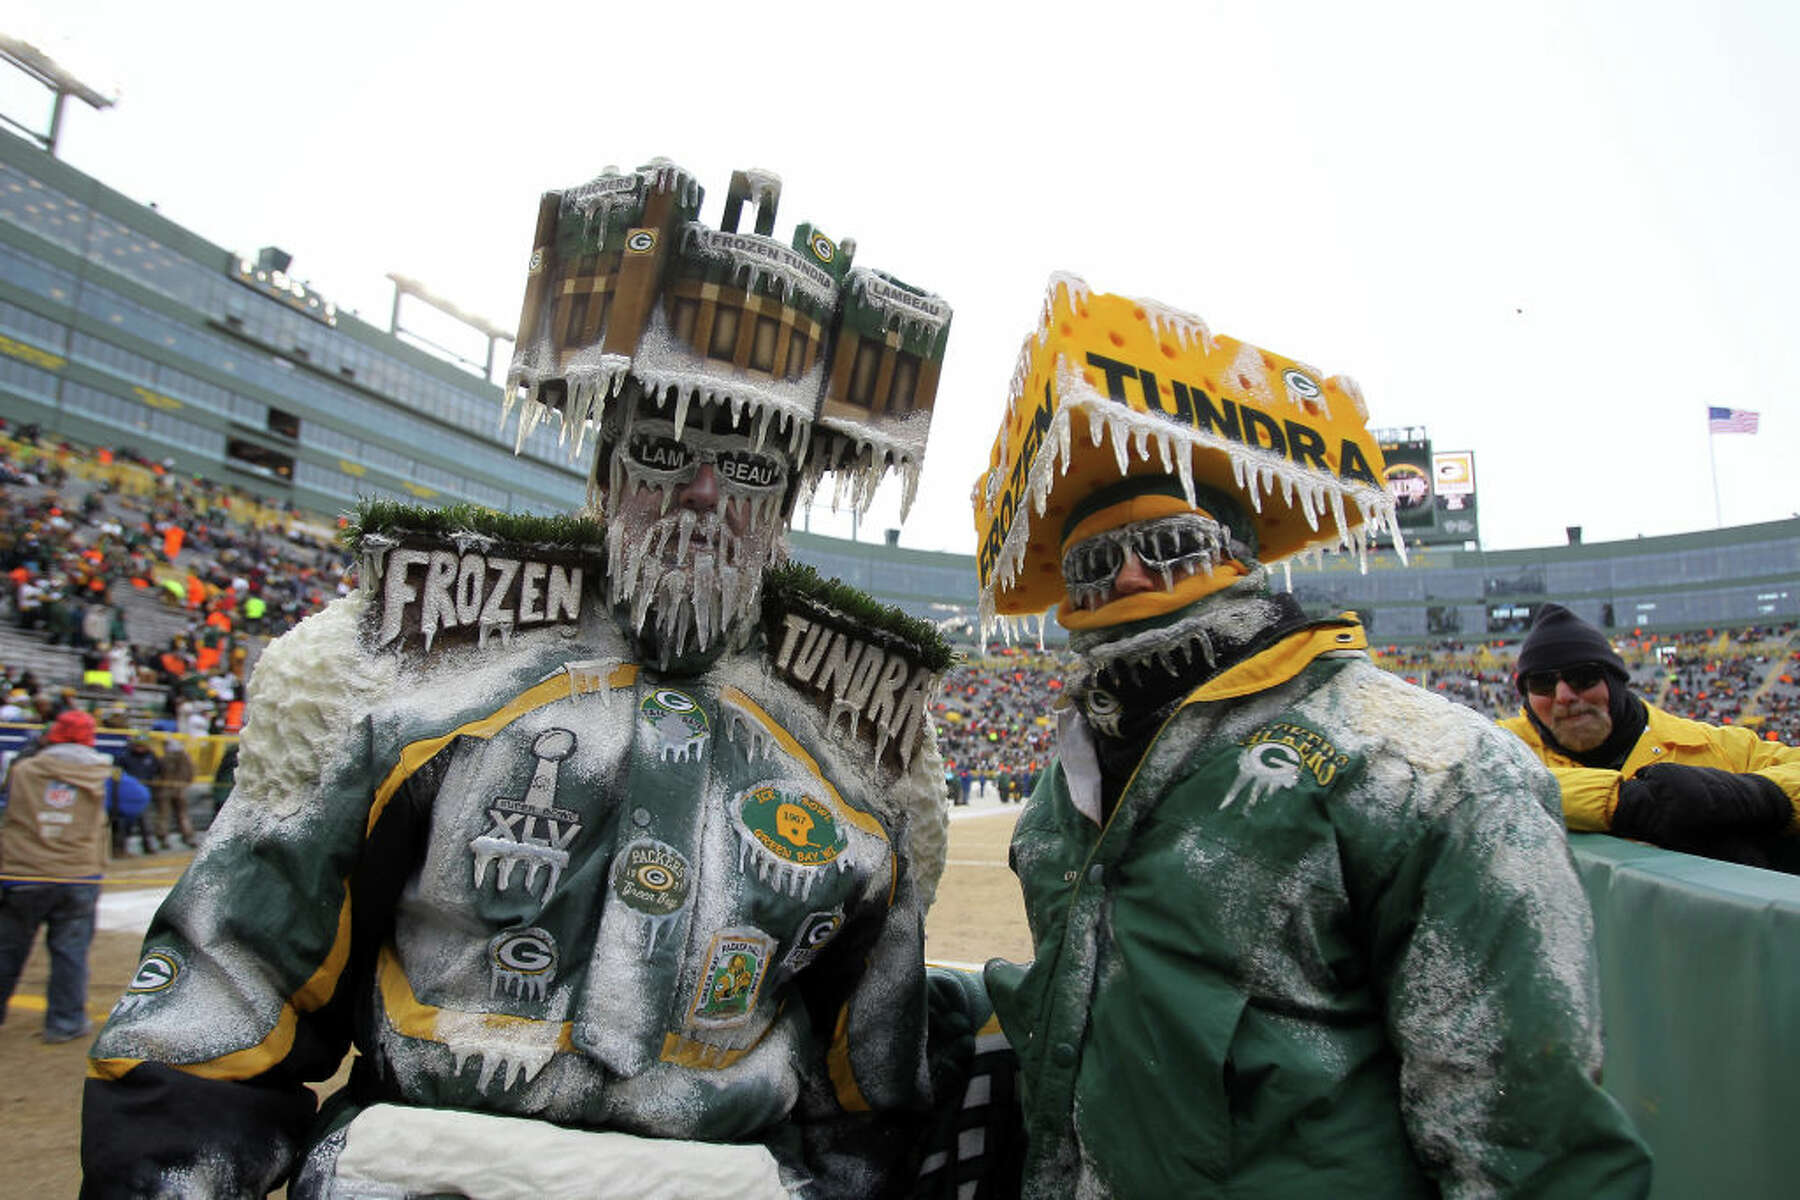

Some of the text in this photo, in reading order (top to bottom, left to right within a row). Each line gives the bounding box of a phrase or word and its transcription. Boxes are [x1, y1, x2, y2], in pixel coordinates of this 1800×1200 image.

[711, 234, 831, 288] FROZEN TUNDRA
[873, 283, 940, 316] LAMBEAU
[1086, 352, 1385, 492] TUNDRA
[642, 445, 684, 468] LAM
[723, 461, 772, 485] BEAU
[980, 379, 1053, 589] FROZEN
[377, 549, 583, 648] FROZEN
[776, 613, 932, 766] TUNDRA
[486, 808, 582, 850] XLV
[784, 811, 806, 825] 1967
[632, 845, 685, 879] PACKERS
[753, 828, 791, 859] GREEN
[796, 851, 819, 862] BAY
[622, 880, 655, 901] Green
[656, 892, 679, 909] Bay
[499, 937, 552, 971] G
